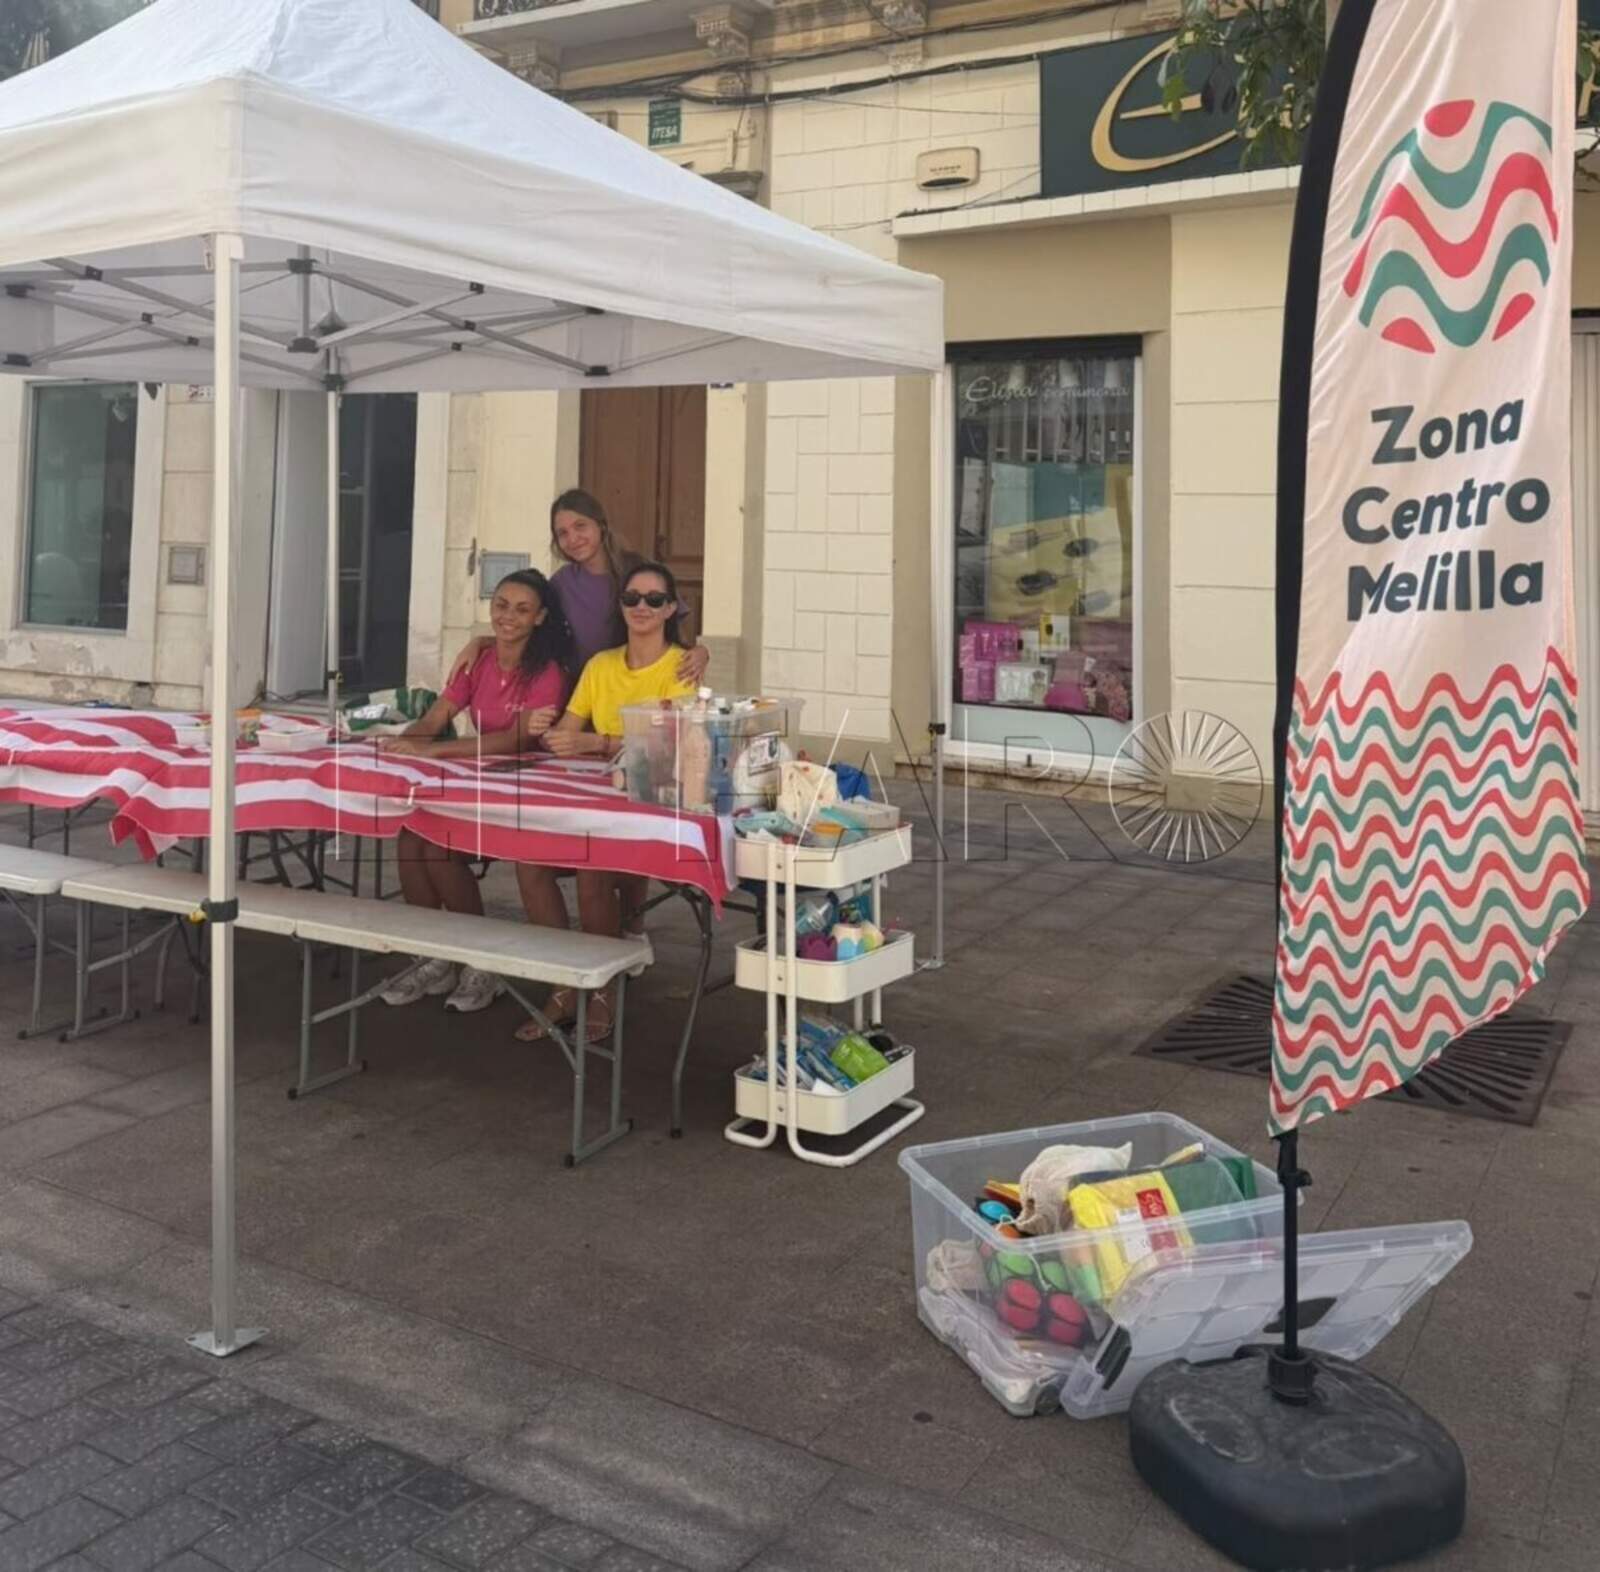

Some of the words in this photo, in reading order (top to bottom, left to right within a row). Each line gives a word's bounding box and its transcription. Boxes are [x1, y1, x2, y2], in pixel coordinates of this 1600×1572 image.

[1371, 398, 1524, 464] Zona
[1342, 478, 1550, 544] Centro
[1347, 550, 1544, 621] Melilla
